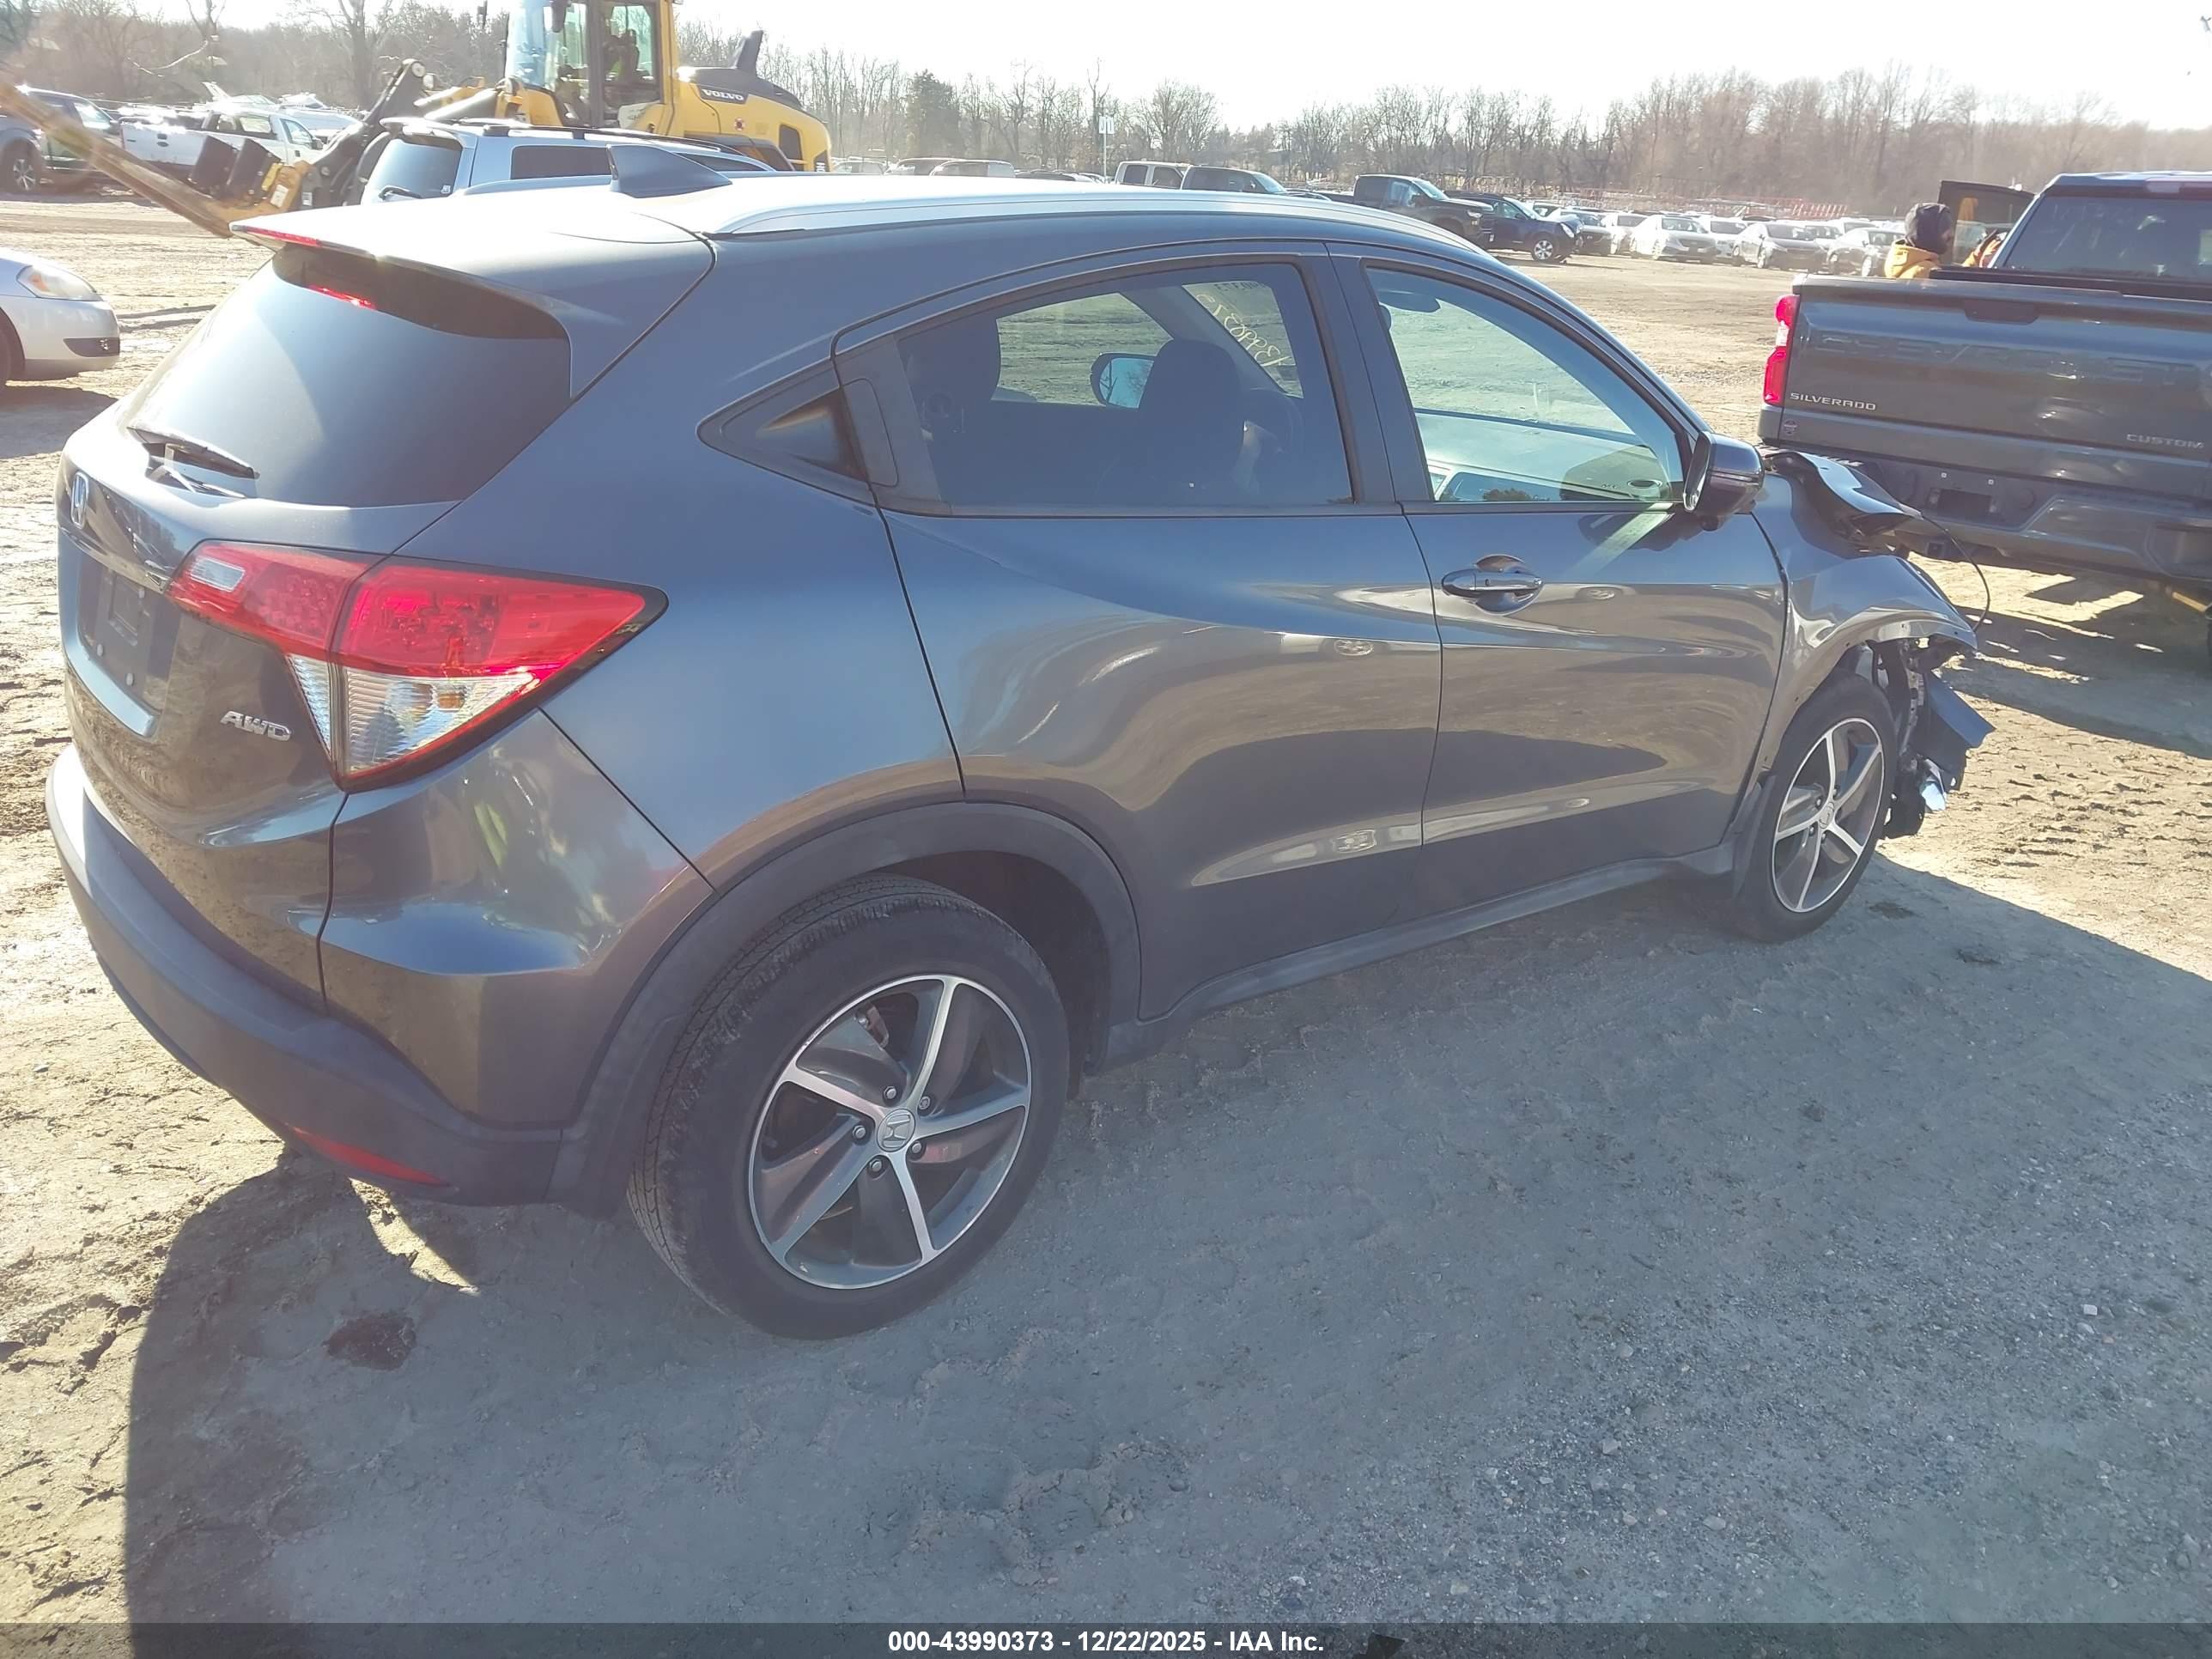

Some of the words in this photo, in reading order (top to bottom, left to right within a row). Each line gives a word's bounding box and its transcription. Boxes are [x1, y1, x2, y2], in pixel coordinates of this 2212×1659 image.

[701, 88, 744, 100] VOLVO
[1790, 392, 1877, 410] SILVERADO
[2126, 434, 2204, 448] CUSTOM
[220, 710, 290, 742] AWD
